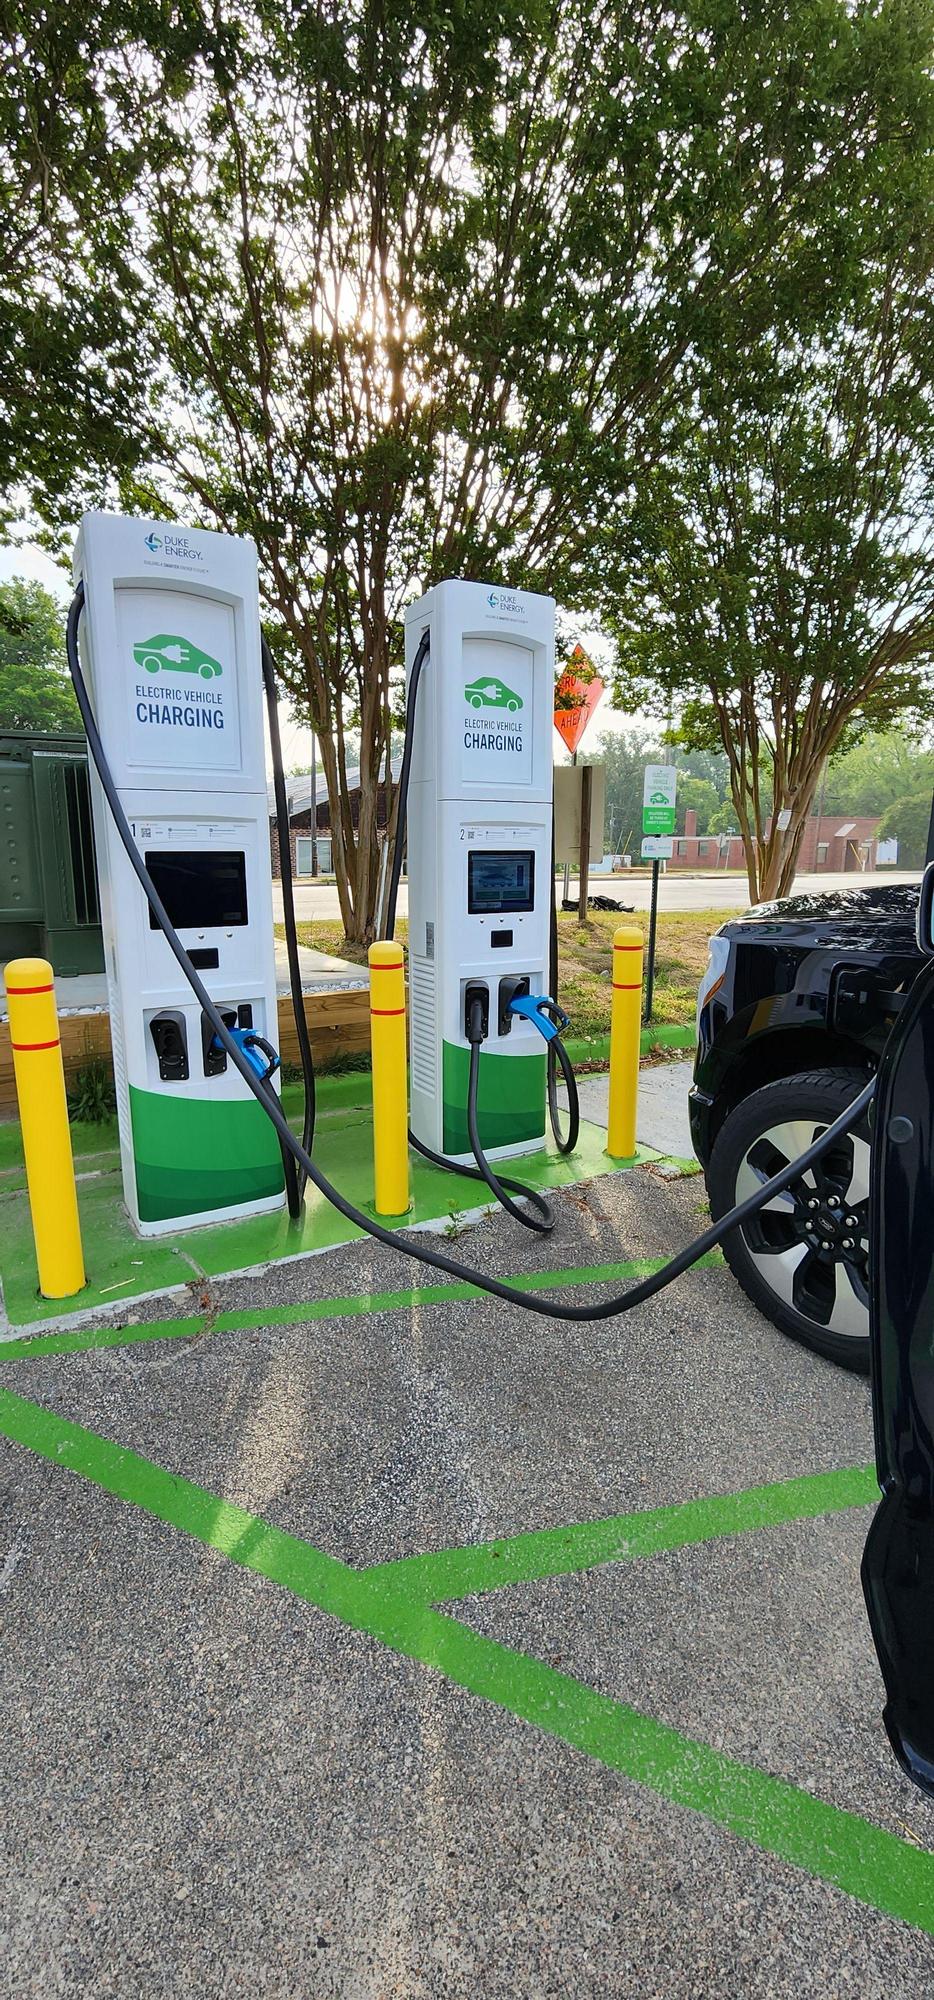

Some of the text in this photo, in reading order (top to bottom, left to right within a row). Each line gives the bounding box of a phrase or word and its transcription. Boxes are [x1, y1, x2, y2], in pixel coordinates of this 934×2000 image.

[164, 535, 190, 548] DUKE
[500, 594, 517, 605] DUKE
[135, 685, 223, 705] ELECTRIC VEHICLE
[136, 702, 224, 729] CHARGING
[464, 718, 523, 732] ELECTRIC VEHICLE
[464, 732, 522, 752] CHARGING
[130, 823, 136, 837] 1
[460, 828, 465, 841] 2
